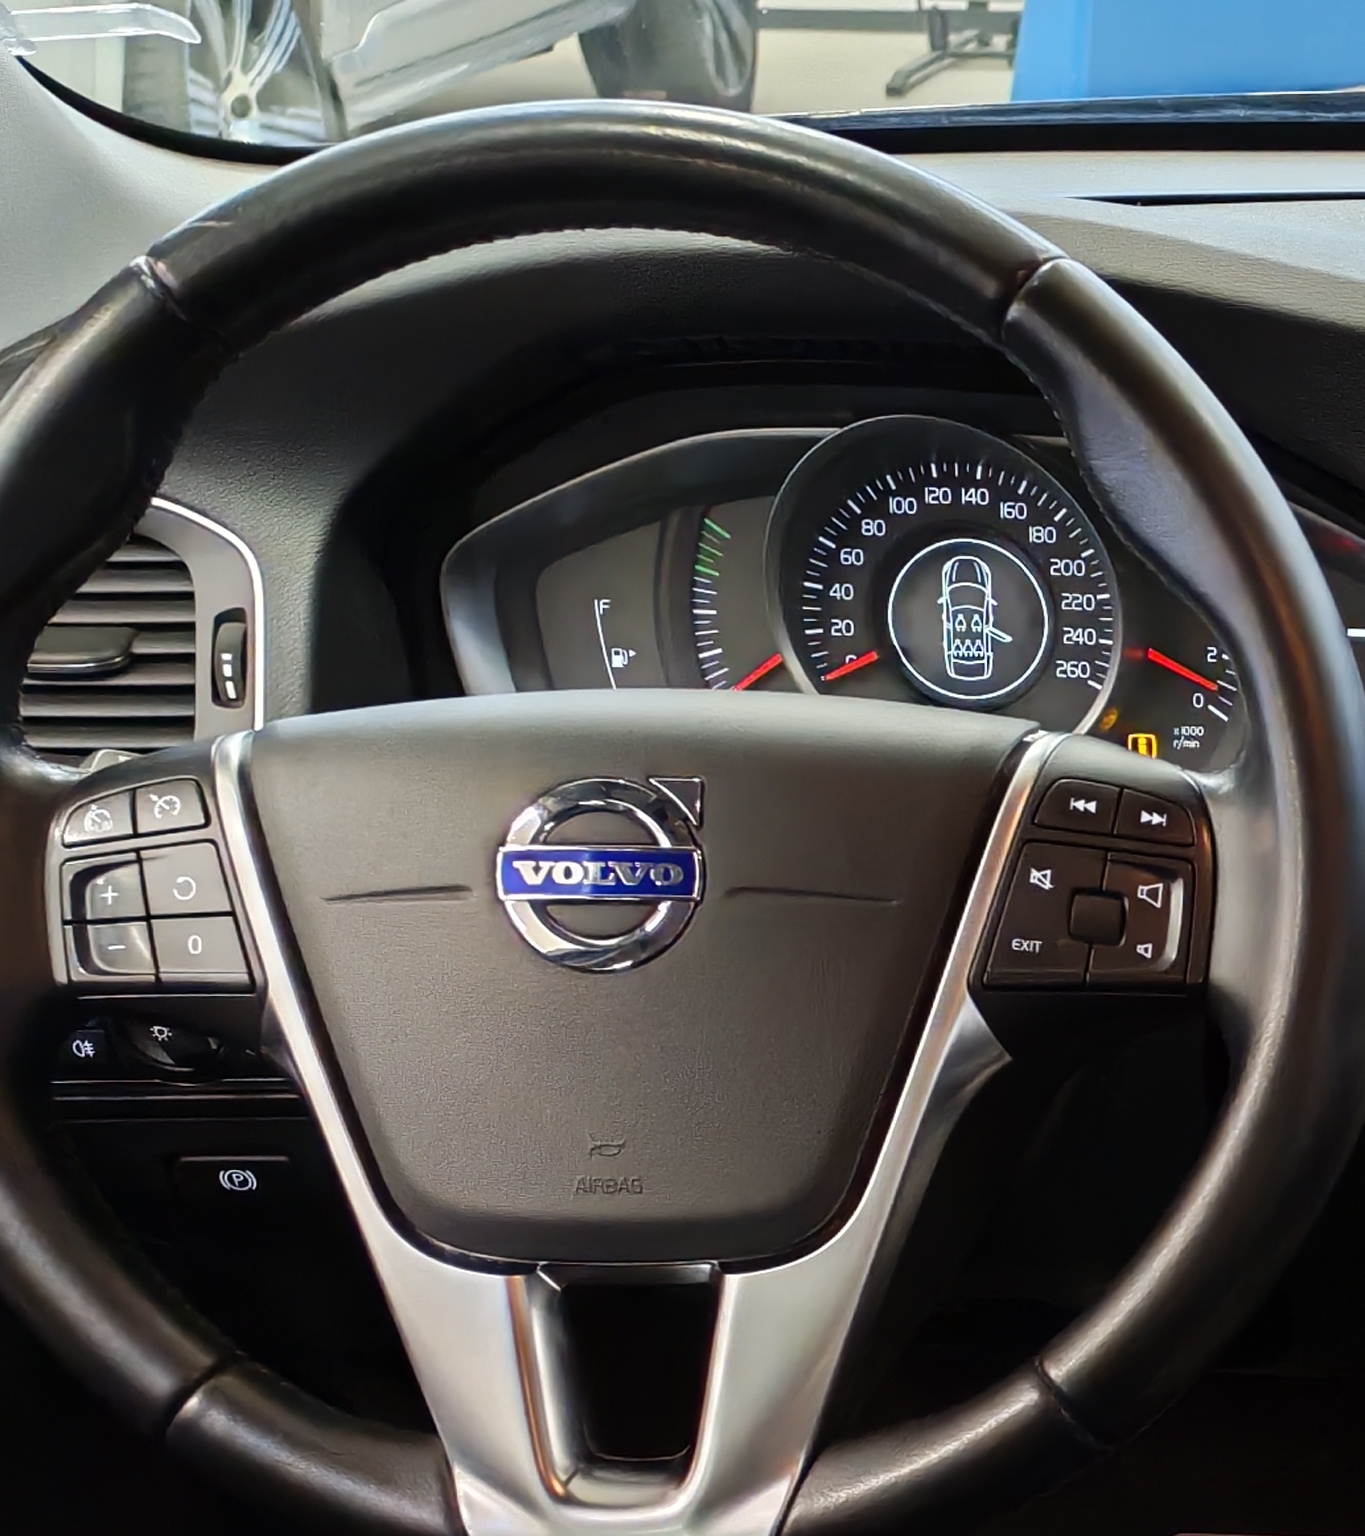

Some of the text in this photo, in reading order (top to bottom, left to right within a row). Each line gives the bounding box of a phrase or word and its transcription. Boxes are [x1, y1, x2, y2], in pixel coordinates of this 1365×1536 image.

[924, 487, 951, 505] 120
[961, 487, 989, 505] 140
[889, 497, 917, 514] 100
[1000, 502, 1027, 519] 160
[861, 519, 886, 536] 80
[1029, 526, 1057, 544] 180
[840, 549, 864, 565] 60
[1050, 558, 1085, 576] 200
[829, 583, 854, 600] 40
[599, 599, 611, 615] F
[1061, 593, 1095, 611] 220
[830, 619, 854, 636] 20
[1063, 627, 1096, 645] 240
[1206, 646, 1218, 662] 2
[1056, 661, 1090, 678] 260
[1192, 693, 1204, 708] 0
[512, 859, 684, 888] VOLVO
[1011, 938, 1042, 954] EXIT
[575, 1175, 643, 1196] AIRBAG
